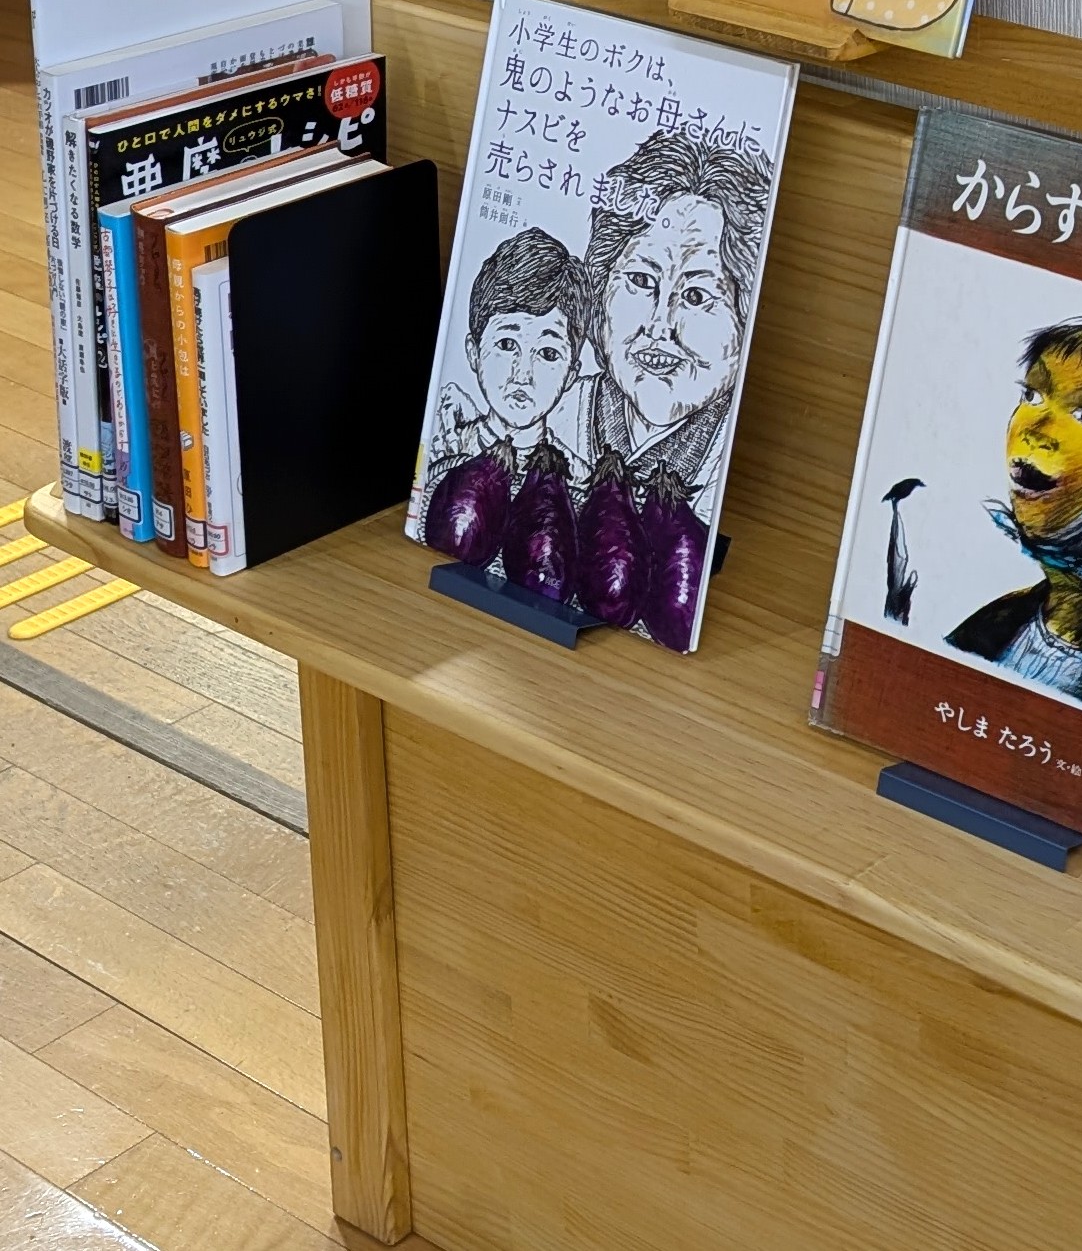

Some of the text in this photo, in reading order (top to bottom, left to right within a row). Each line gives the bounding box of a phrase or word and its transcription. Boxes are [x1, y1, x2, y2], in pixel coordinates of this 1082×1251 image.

[509, 17, 673, 88] 小学生のボクは、
[330, 79, 373, 103] 低糖質
[499, 54, 767, 154] 鬼のようなお母さんに
[228, 124, 278, 146] リュウジ式
[496, 99, 587, 153] ナスビを
[64, 130, 82, 250] 解きたくなる数学
[482, 187, 513, 206] 原田剛
[484, 140, 671, 229] 売らされました。
[934, 702, 989, 739] やしま
[998, 726, 1052, 764] たろう
